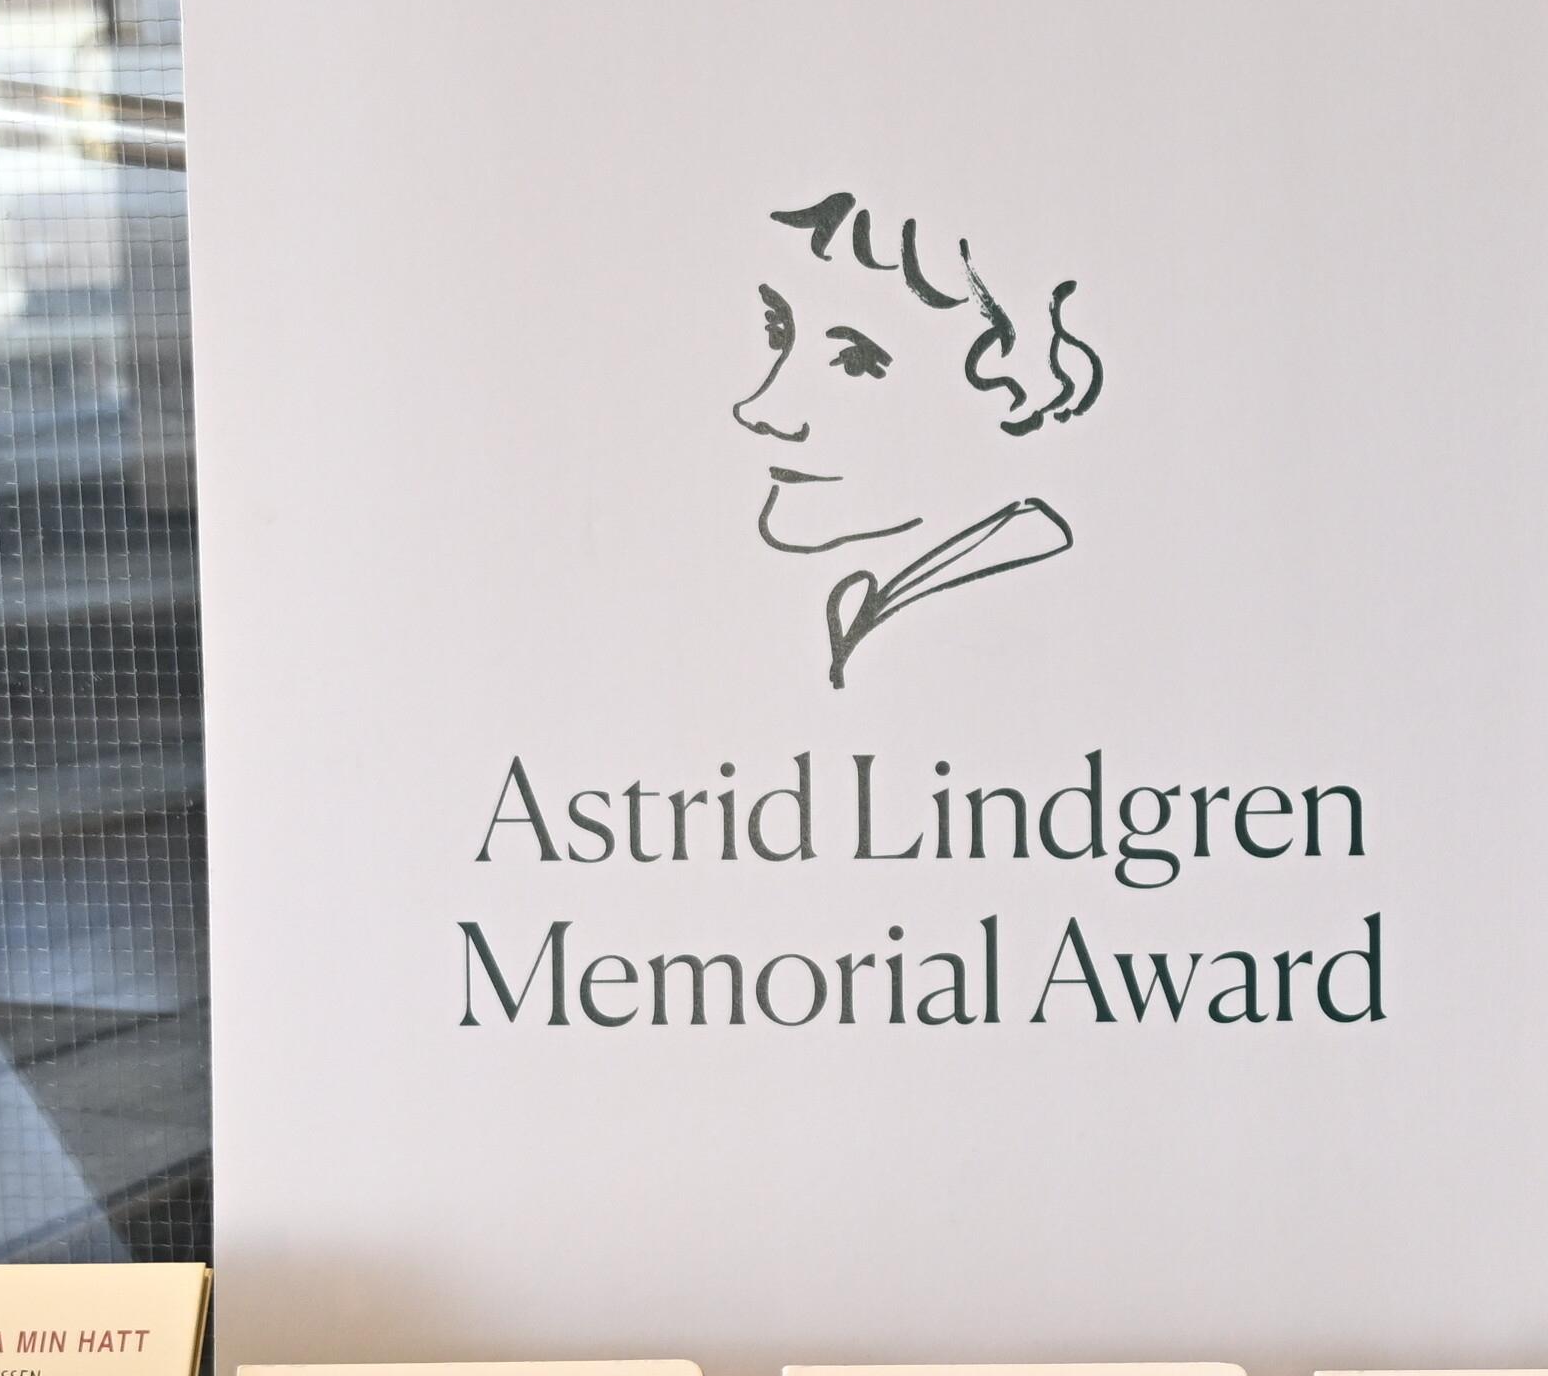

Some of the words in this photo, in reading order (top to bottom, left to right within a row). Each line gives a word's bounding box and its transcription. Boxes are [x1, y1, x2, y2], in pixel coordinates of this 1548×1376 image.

[474, 751, 817, 864] Astrid
[852, 748, 1366, 890] Lindgren
[457, 914, 1001, 1028] Memorial
[1029, 911, 1387, 1024] Award
[16, 1330, 67, 1354] MIN
[78, 1329, 151, 1353] HATT
